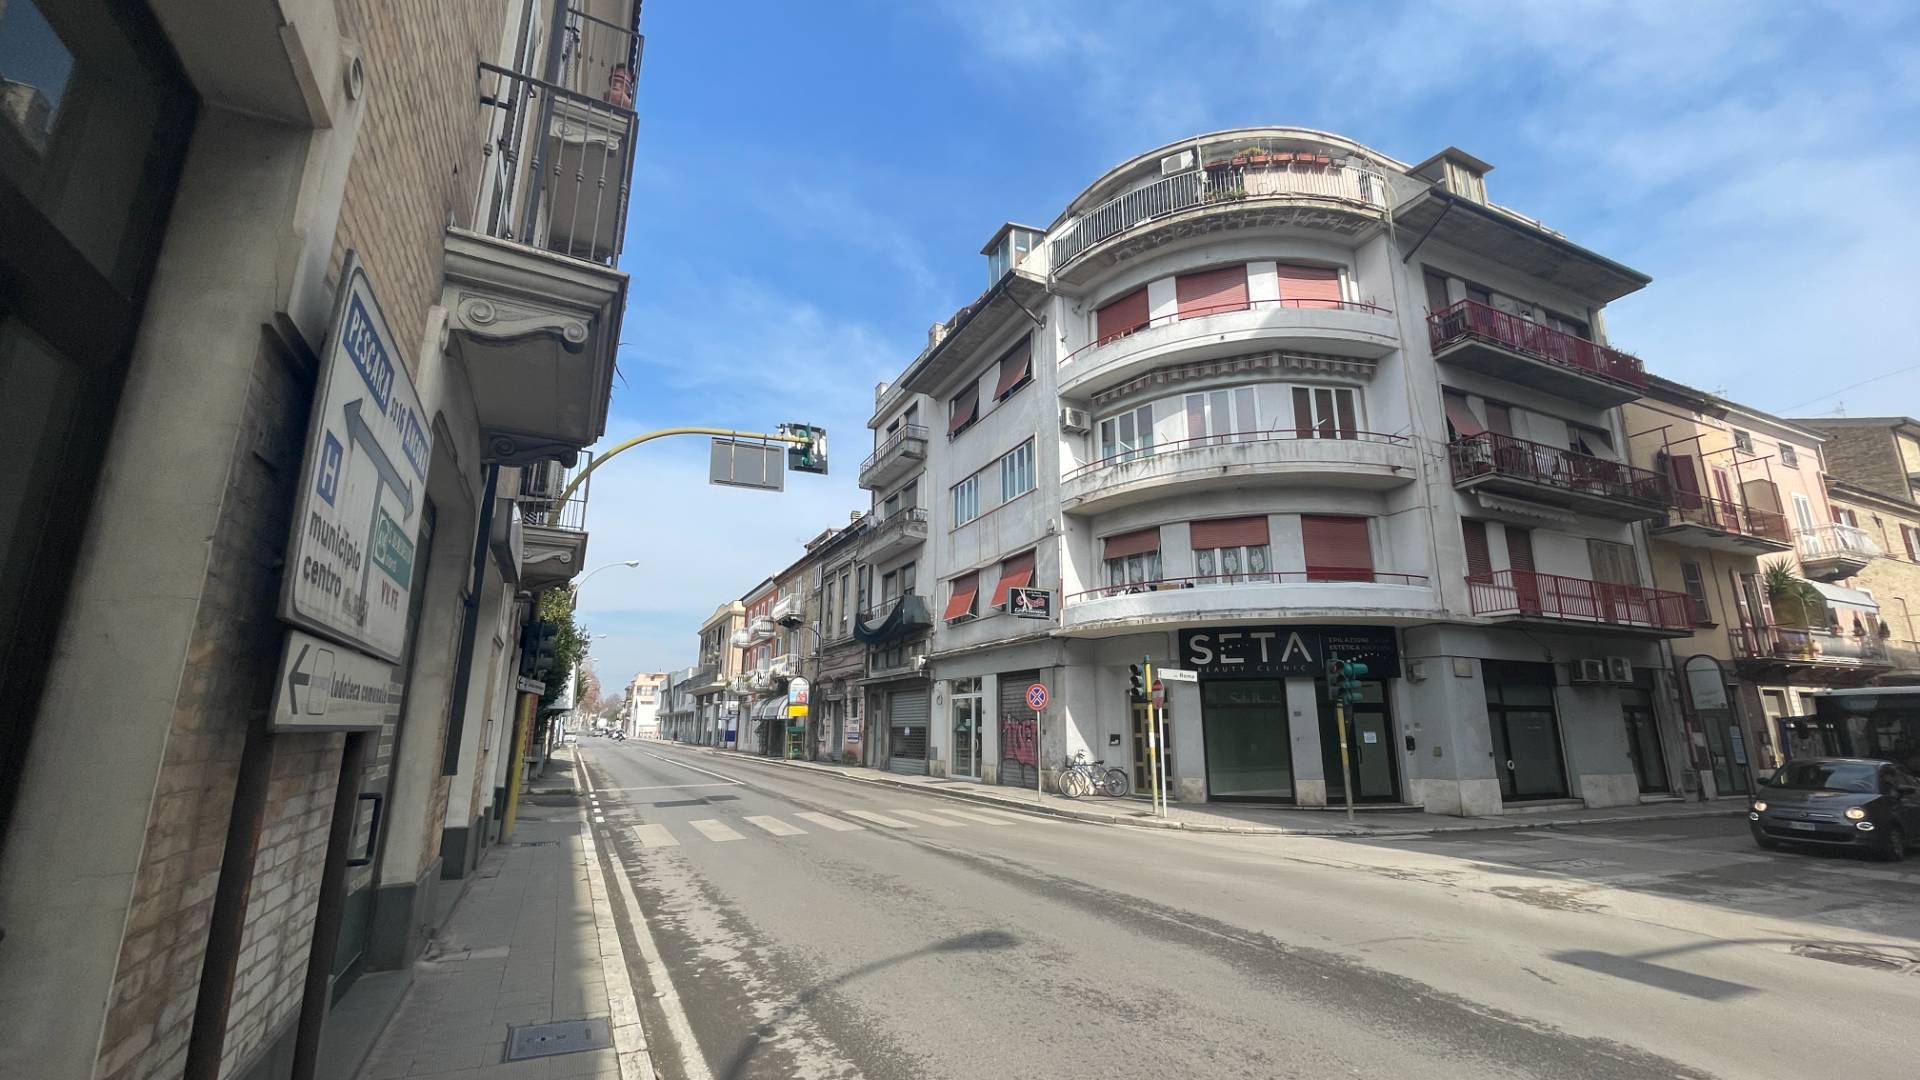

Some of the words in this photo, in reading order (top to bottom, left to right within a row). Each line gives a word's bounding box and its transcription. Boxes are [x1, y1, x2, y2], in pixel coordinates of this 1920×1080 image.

[348, 307, 389, 404] PESCARA
[322, 443, 339, 492] H
[309, 511, 361, 572] municipio
[304, 556, 342, 597] centro
[1189, 631, 1313, 665] SETA
